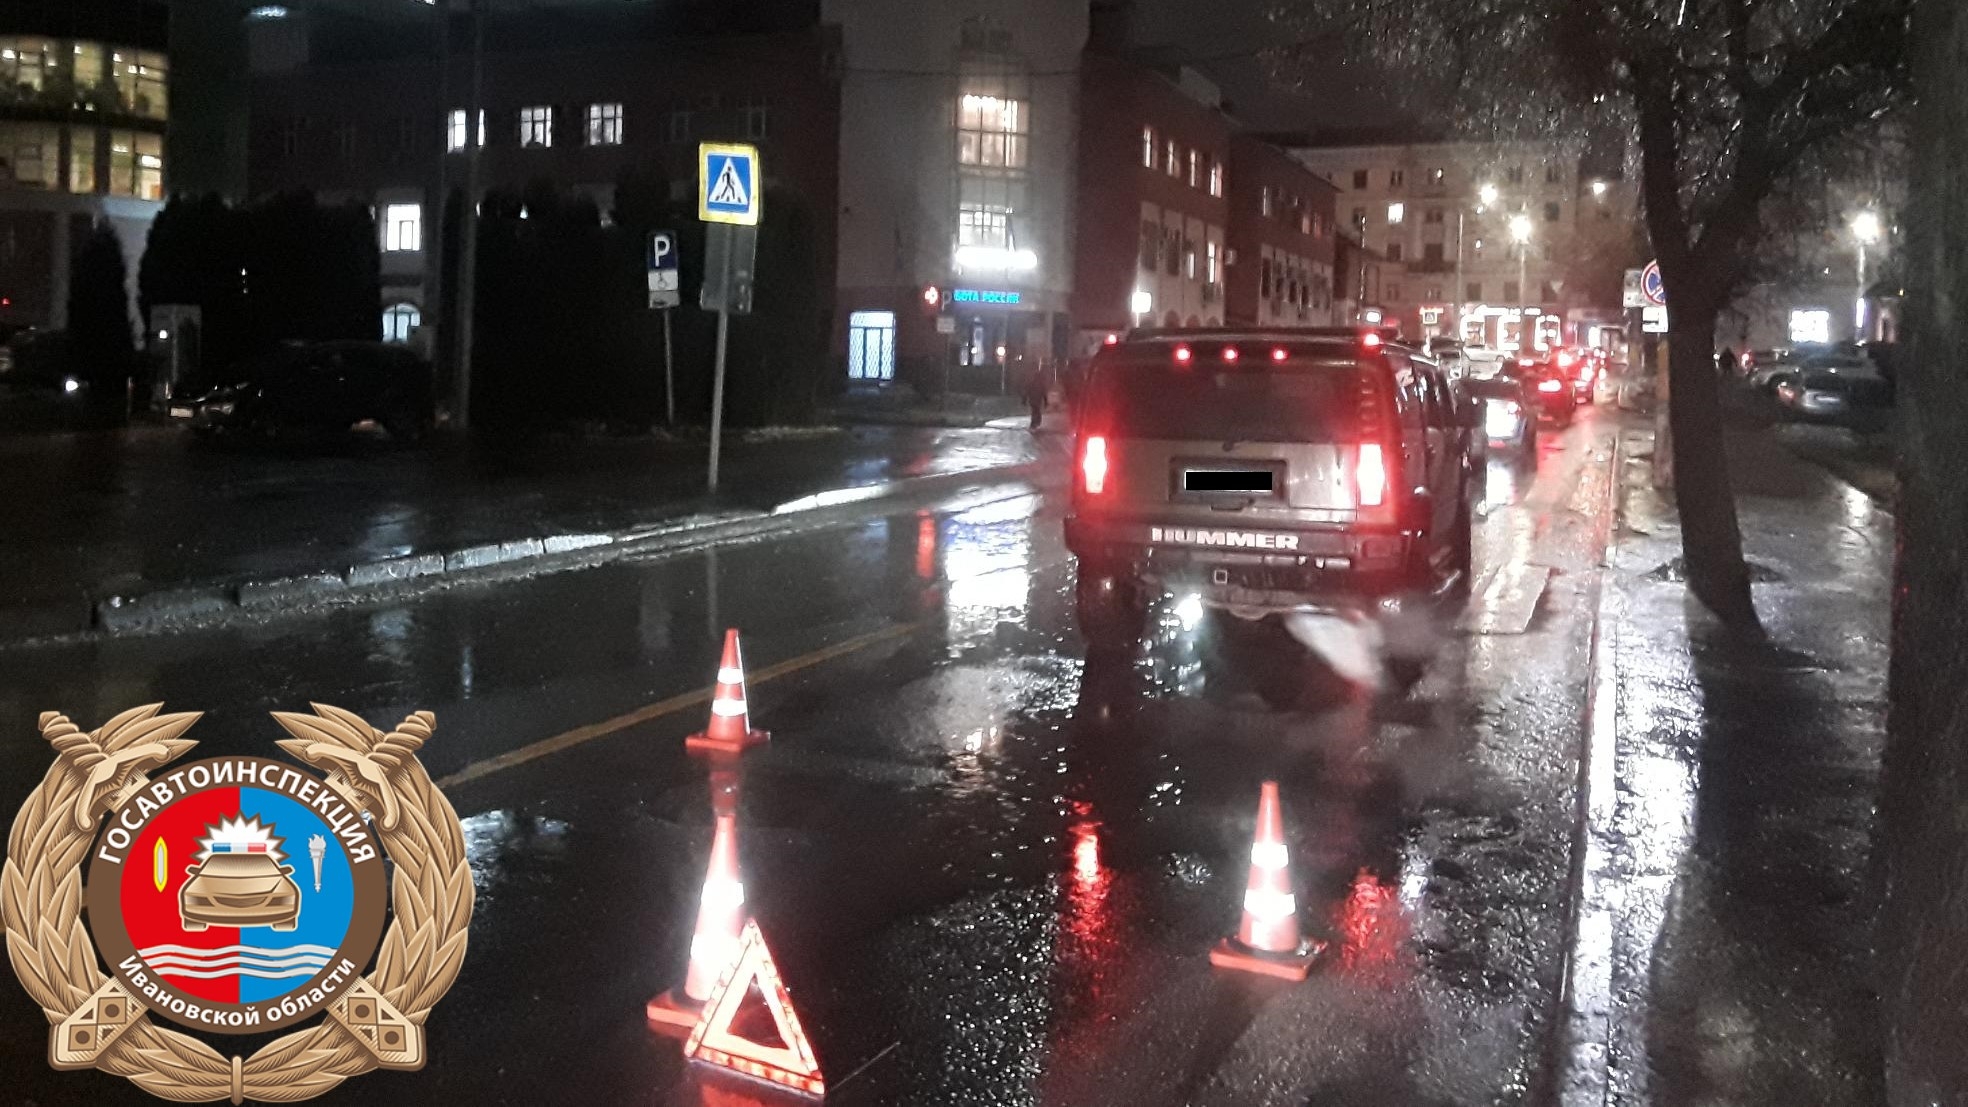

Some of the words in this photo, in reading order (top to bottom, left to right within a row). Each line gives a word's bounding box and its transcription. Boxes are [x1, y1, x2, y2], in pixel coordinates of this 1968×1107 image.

[654, 235, 670, 268] P
[954, 289, 979, 302] БОТА
[1151, 527, 1299, 550] HUMMER
